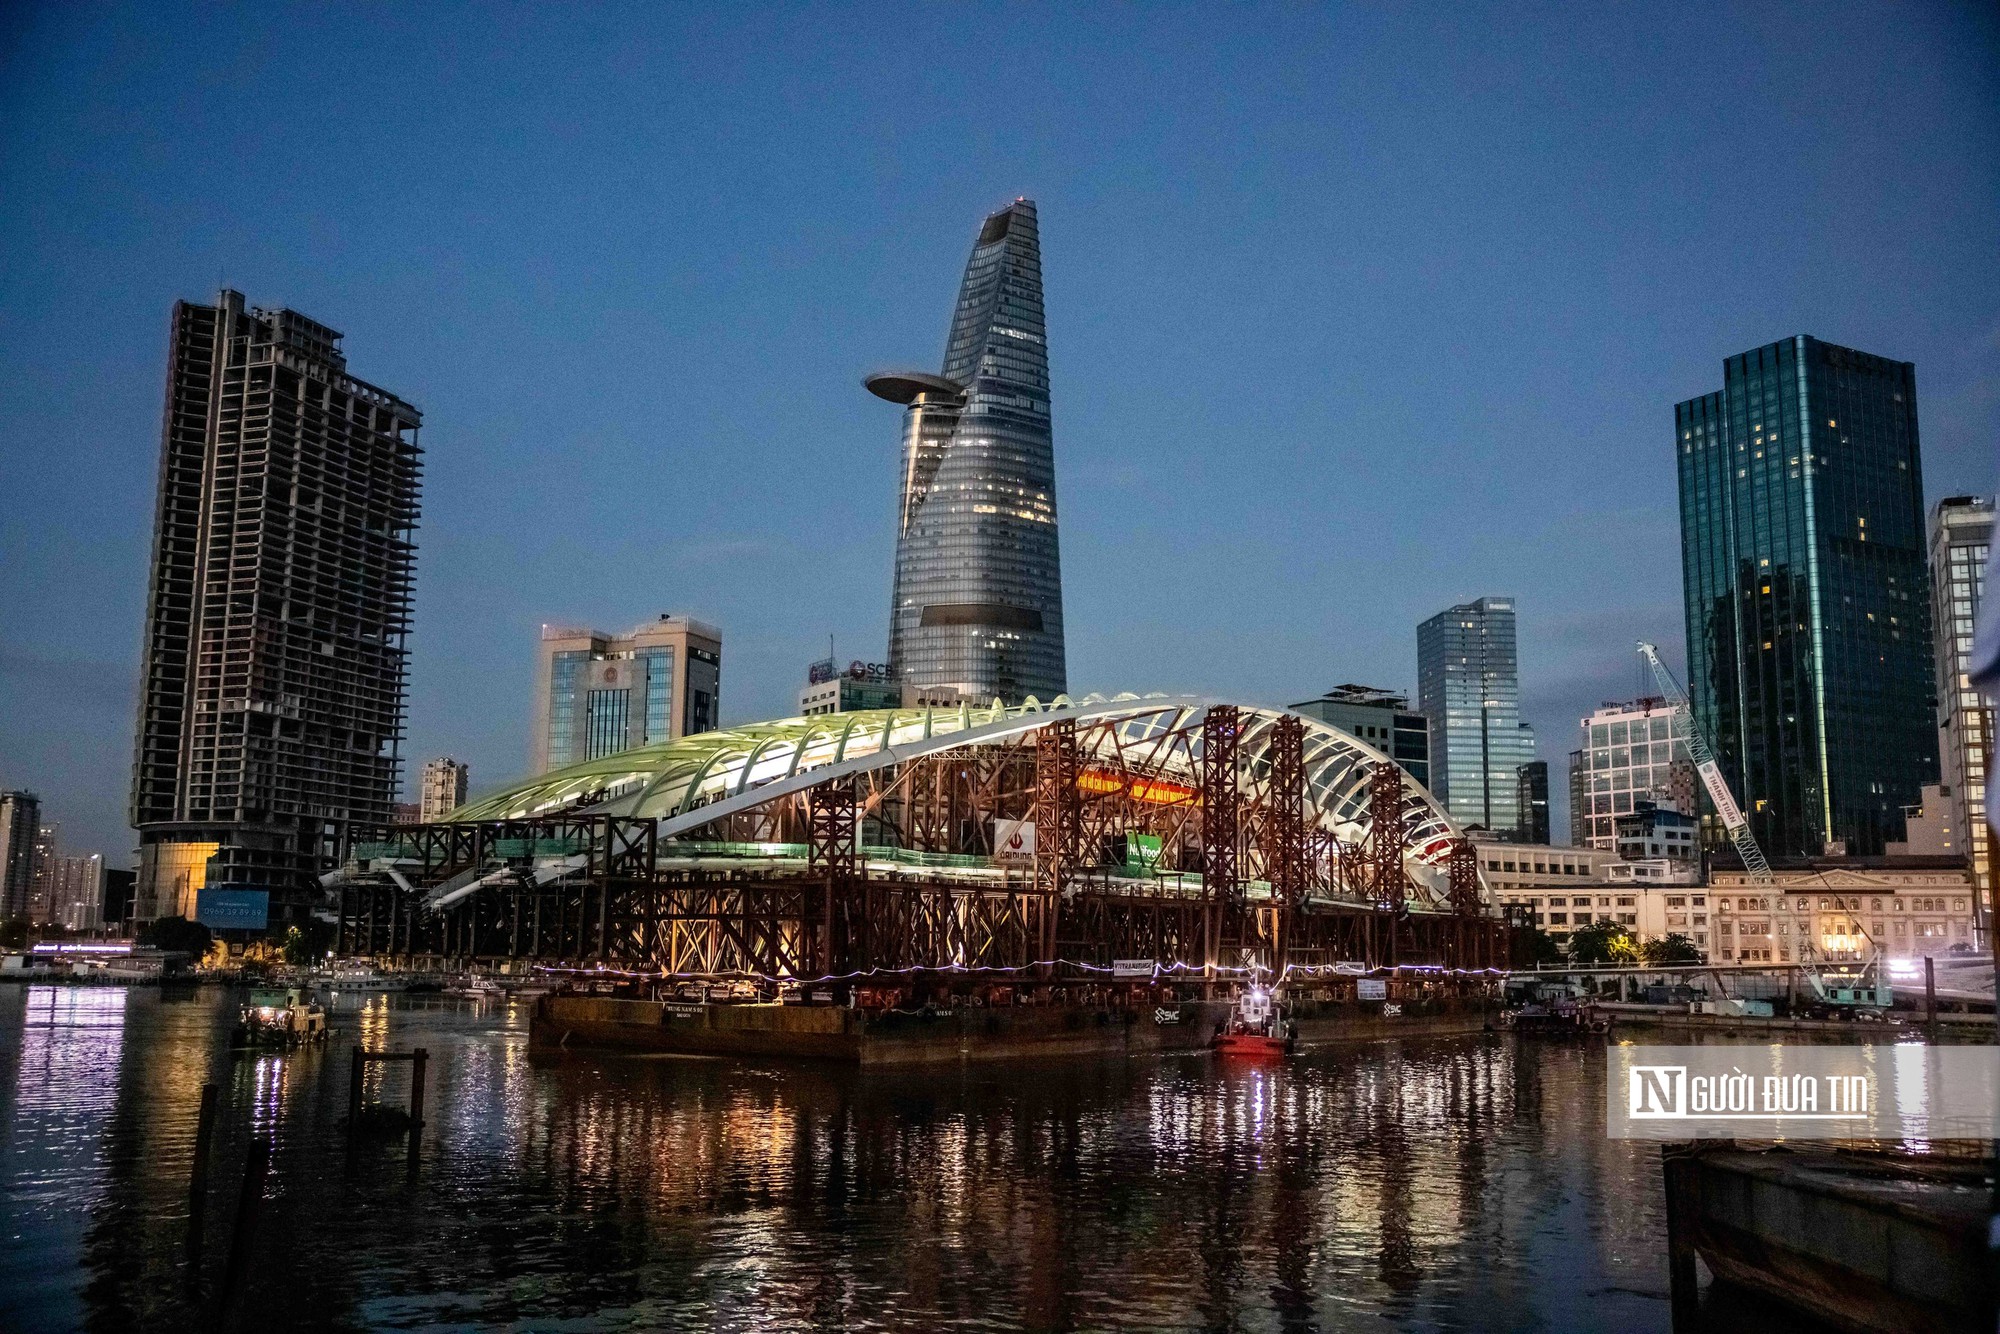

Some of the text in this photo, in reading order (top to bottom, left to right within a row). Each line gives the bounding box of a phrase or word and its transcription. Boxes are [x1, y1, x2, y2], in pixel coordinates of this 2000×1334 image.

[867, 663, 892, 676] SCB
[1709, 775, 1726, 802] THANH
[1130, 843, 1161, 858] Nuifood
